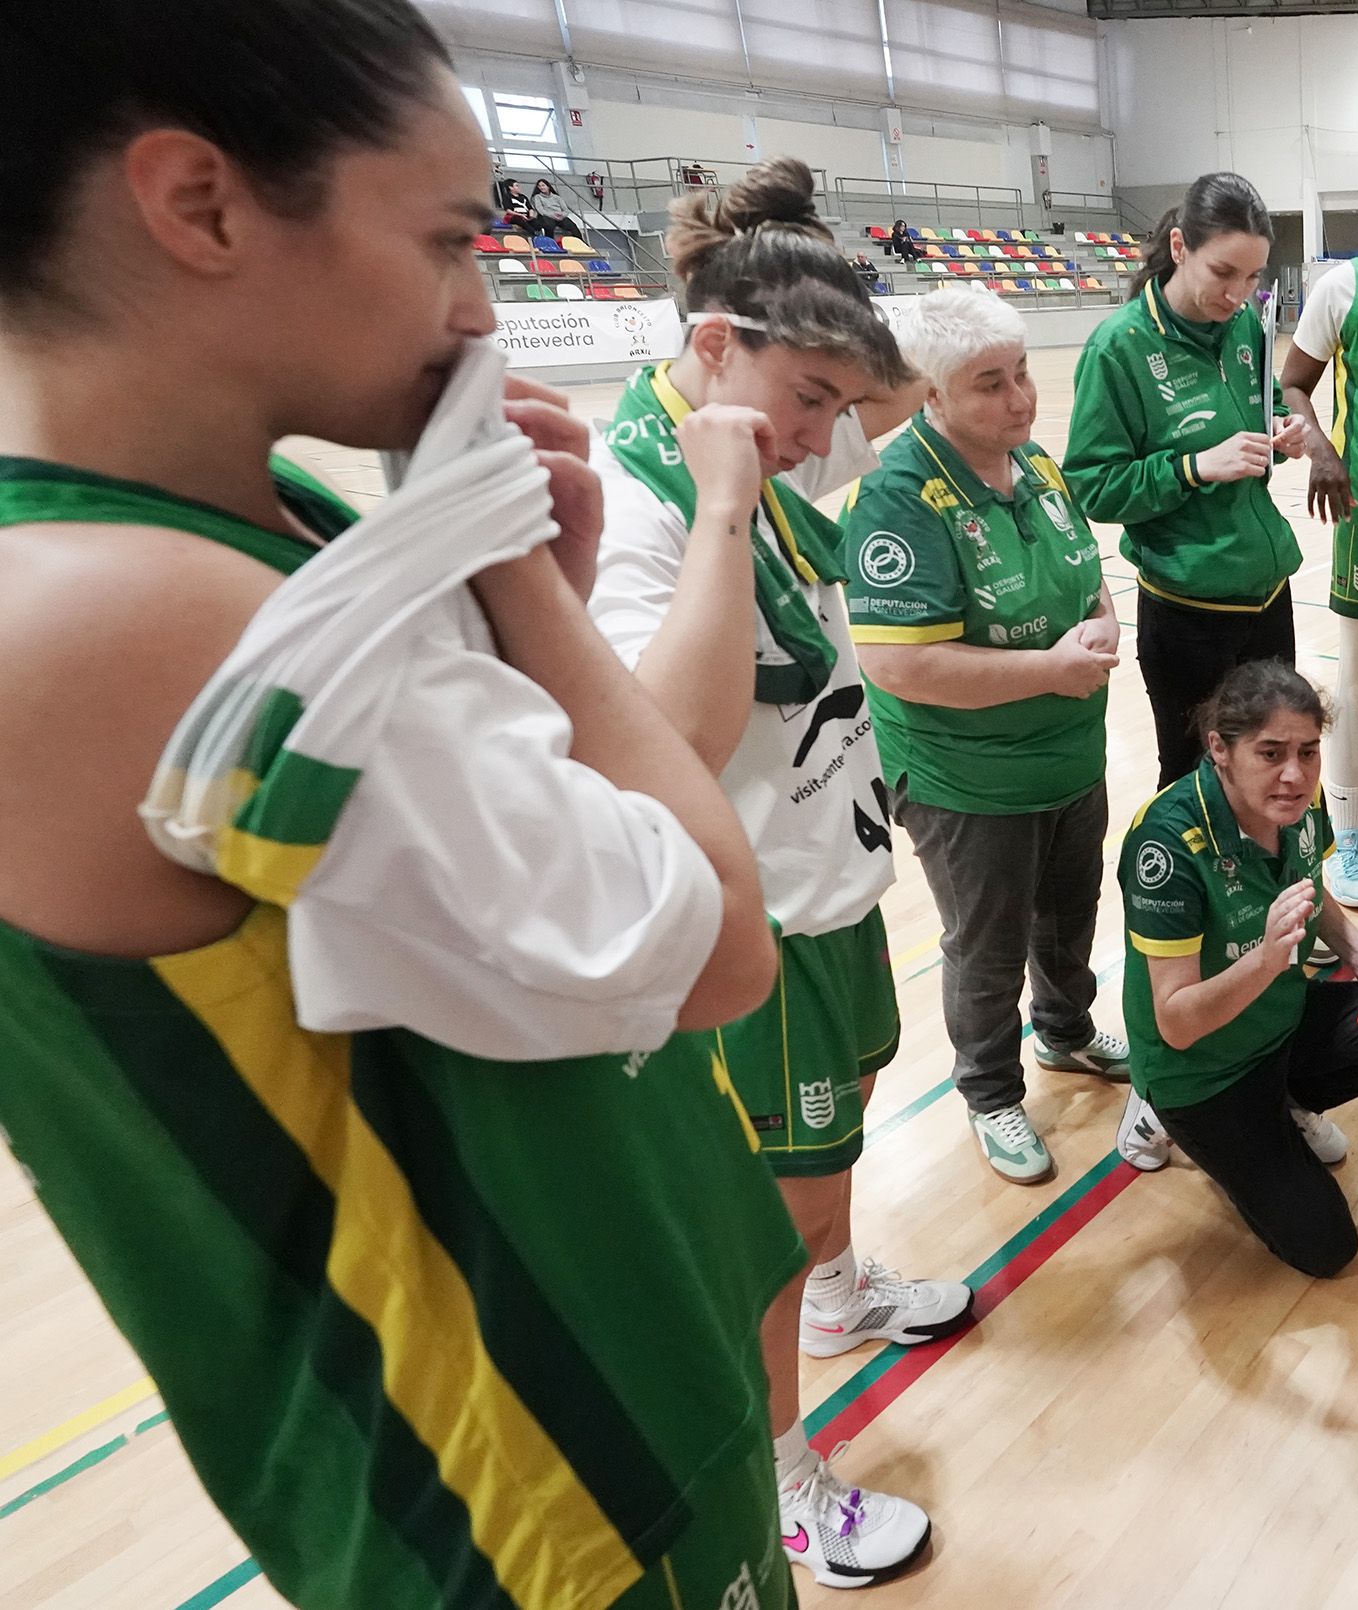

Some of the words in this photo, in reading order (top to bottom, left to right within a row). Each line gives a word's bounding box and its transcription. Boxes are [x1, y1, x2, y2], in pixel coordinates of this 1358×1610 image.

[496, 313, 590, 335] eputación
[497, 332, 594, 350] ontevedra
[1010, 615, 1048, 639] ence
[1240, 935, 1264, 953] enc
